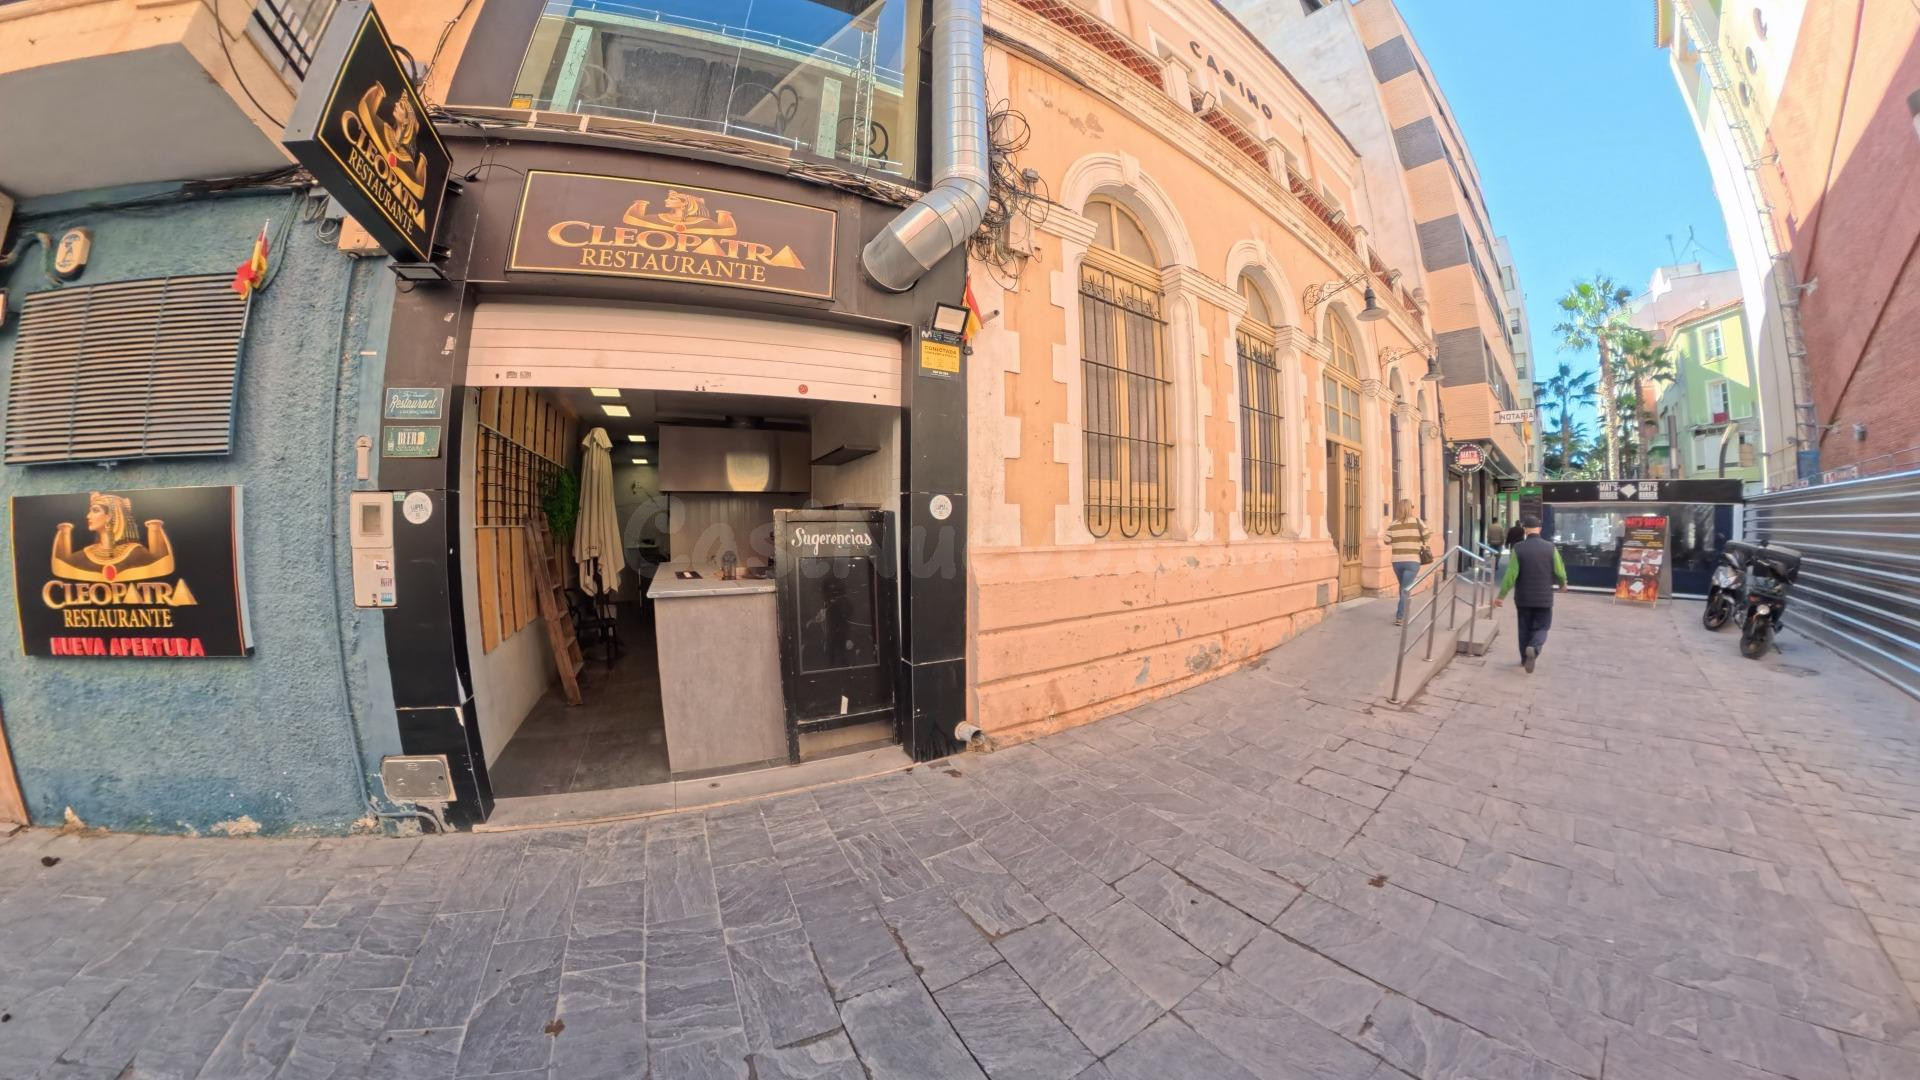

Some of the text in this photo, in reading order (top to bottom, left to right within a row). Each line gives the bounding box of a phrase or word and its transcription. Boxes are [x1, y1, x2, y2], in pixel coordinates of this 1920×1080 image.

[341, 110, 426, 232] CLEOPATRA
[348, 147, 415, 235] RESTAURANTE
[547, 220, 805, 270] CLEOPATRA
[580, 248, 766, 282] RESTAURANTE
[389, 394, 438, 413] Restaurant
[791, 527, 872, 556] Sugerencias
[42, 577, 198, 609] CLEOPATRA
[63, 609, 174, 628] RESTAURANTE
[50, 637, 205, 656] NUEVA APERTURA
